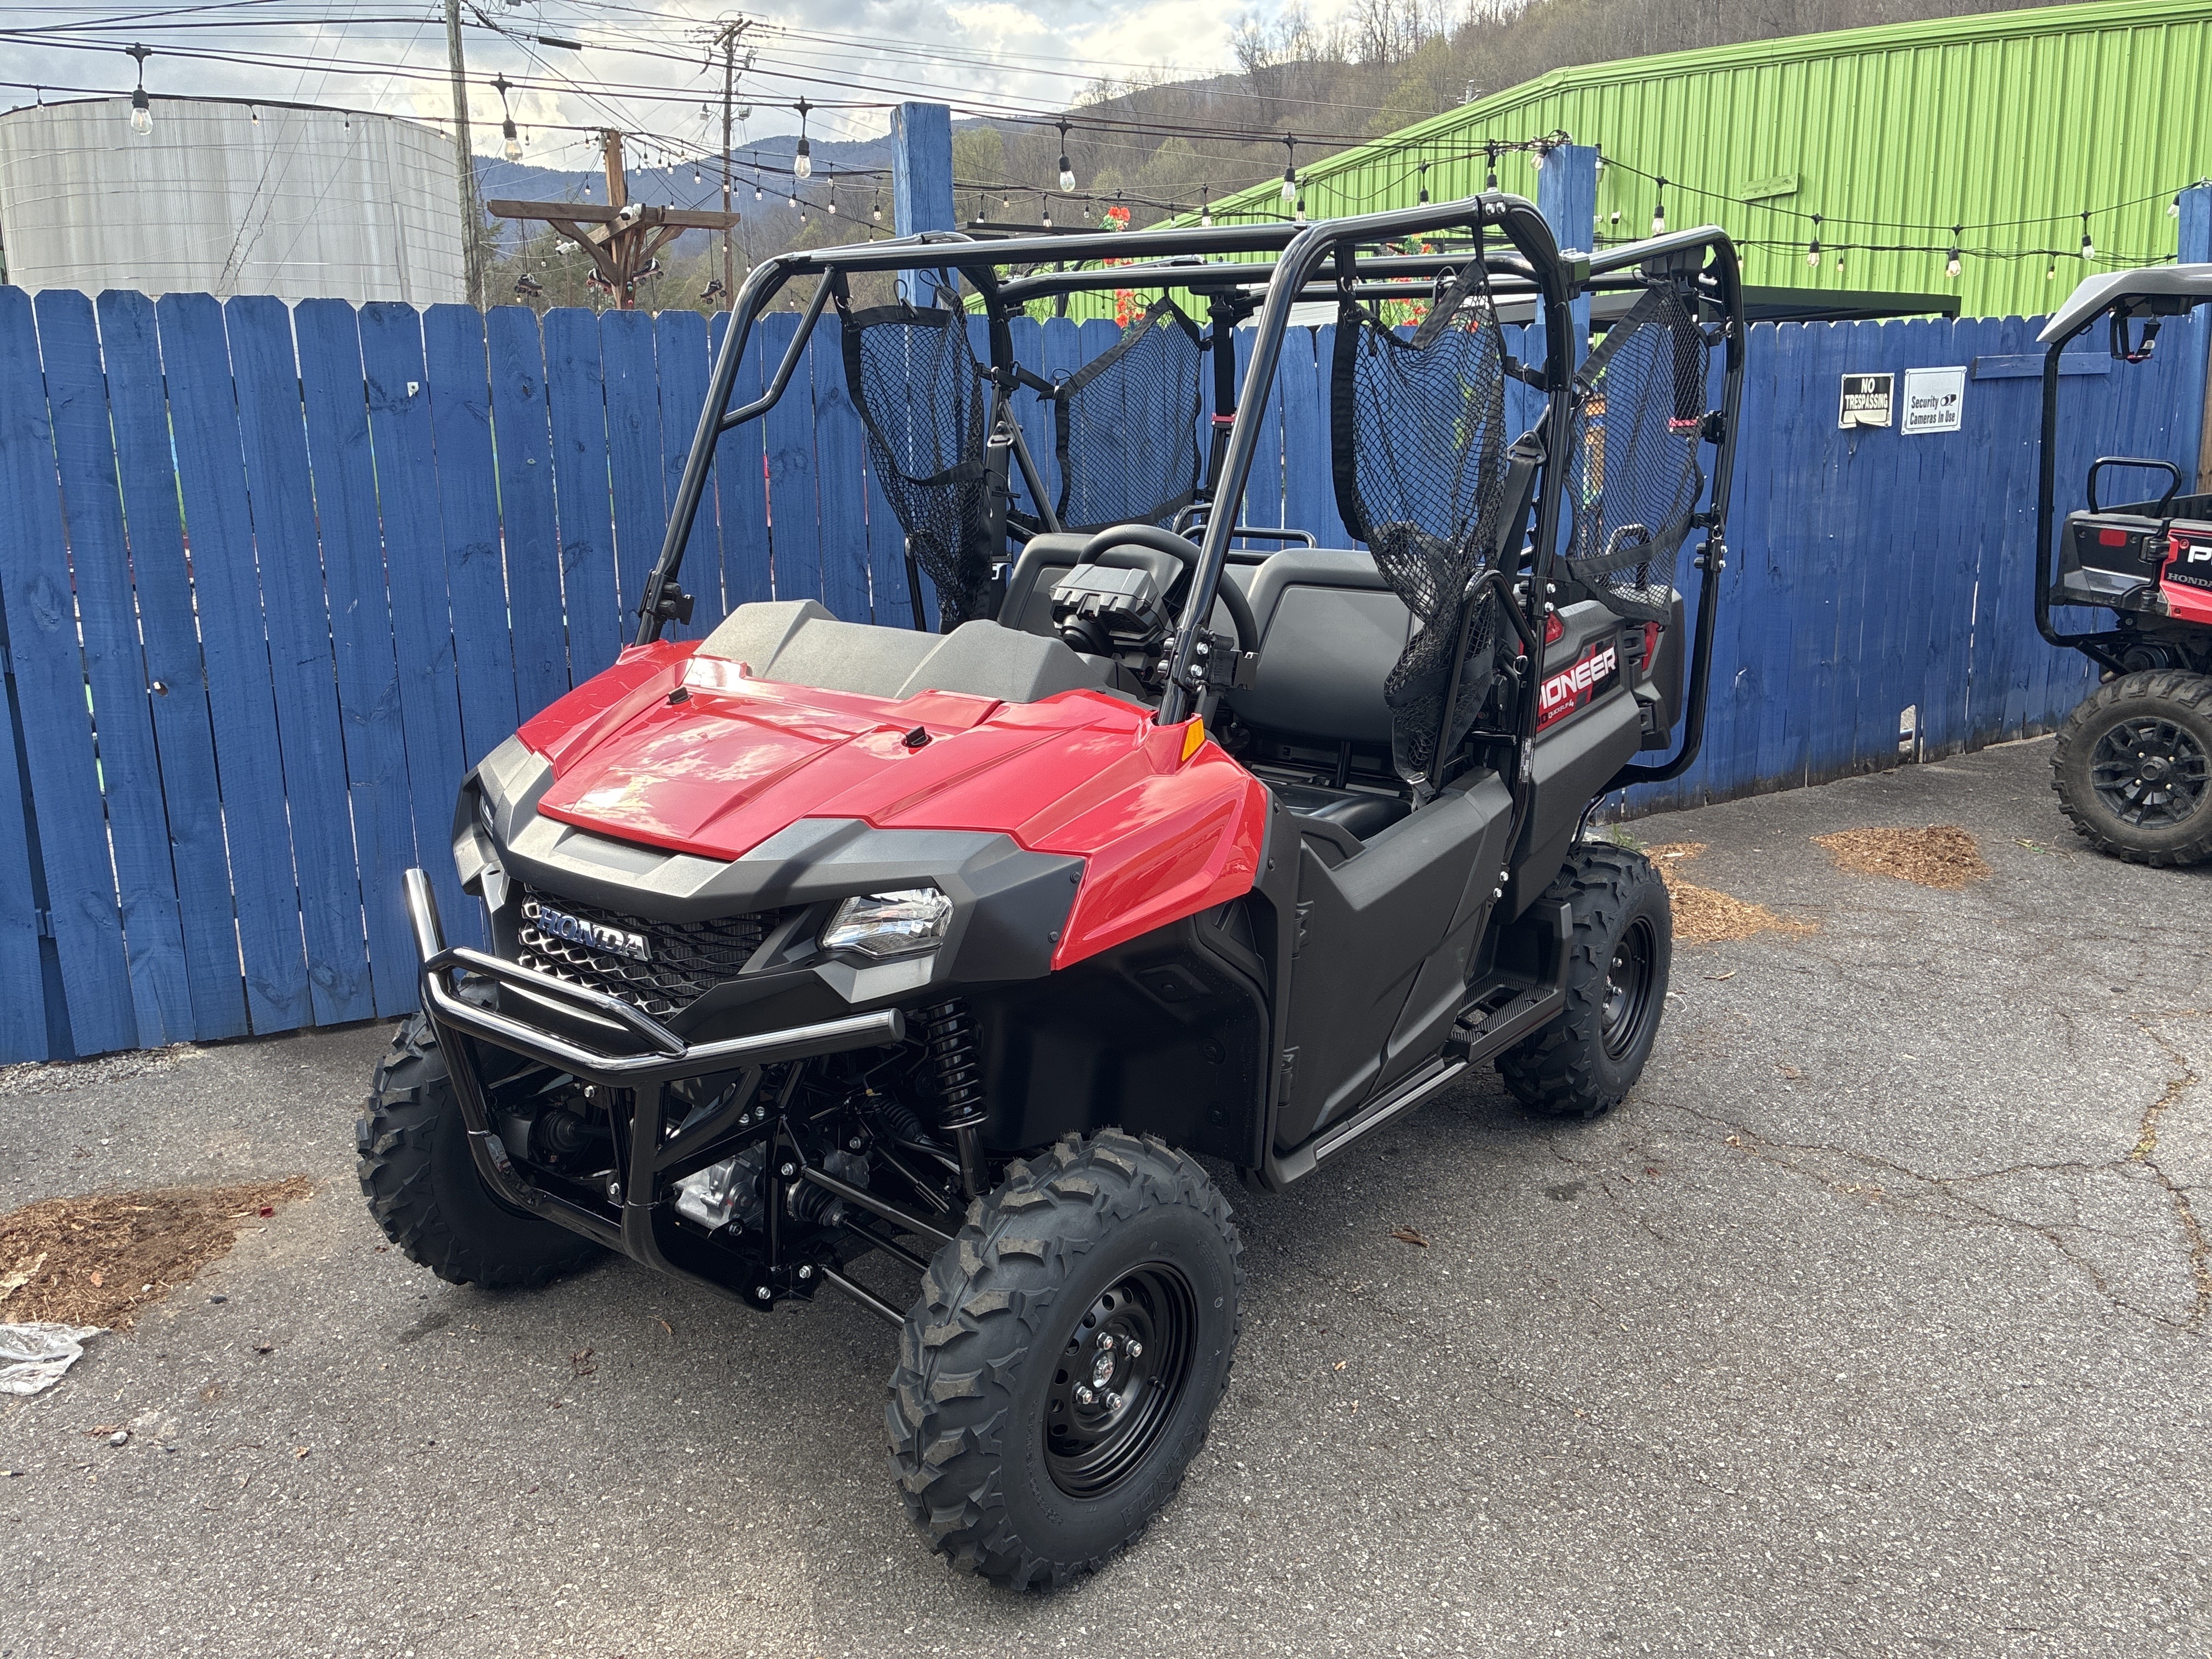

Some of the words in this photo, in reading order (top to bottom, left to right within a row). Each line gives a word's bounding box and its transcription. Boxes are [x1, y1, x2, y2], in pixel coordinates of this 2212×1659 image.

[1861, 377, 1875, 393] NO
[1845, 393, 1888, 410] TRESPASSING
[1911, 394, 1939, 410] Security
[1910, 412, 1937, 425] Cameras
[1938, 410, 1944, 423] In
[1945, 410, 1955, 422] Use
[2187, 545, 2212, 565] P
[1539, 647, 1616, 710] IONEER
[537, 906, 651, 962] HONDA
[1120, 1412, 1203, 1527] KENDA
